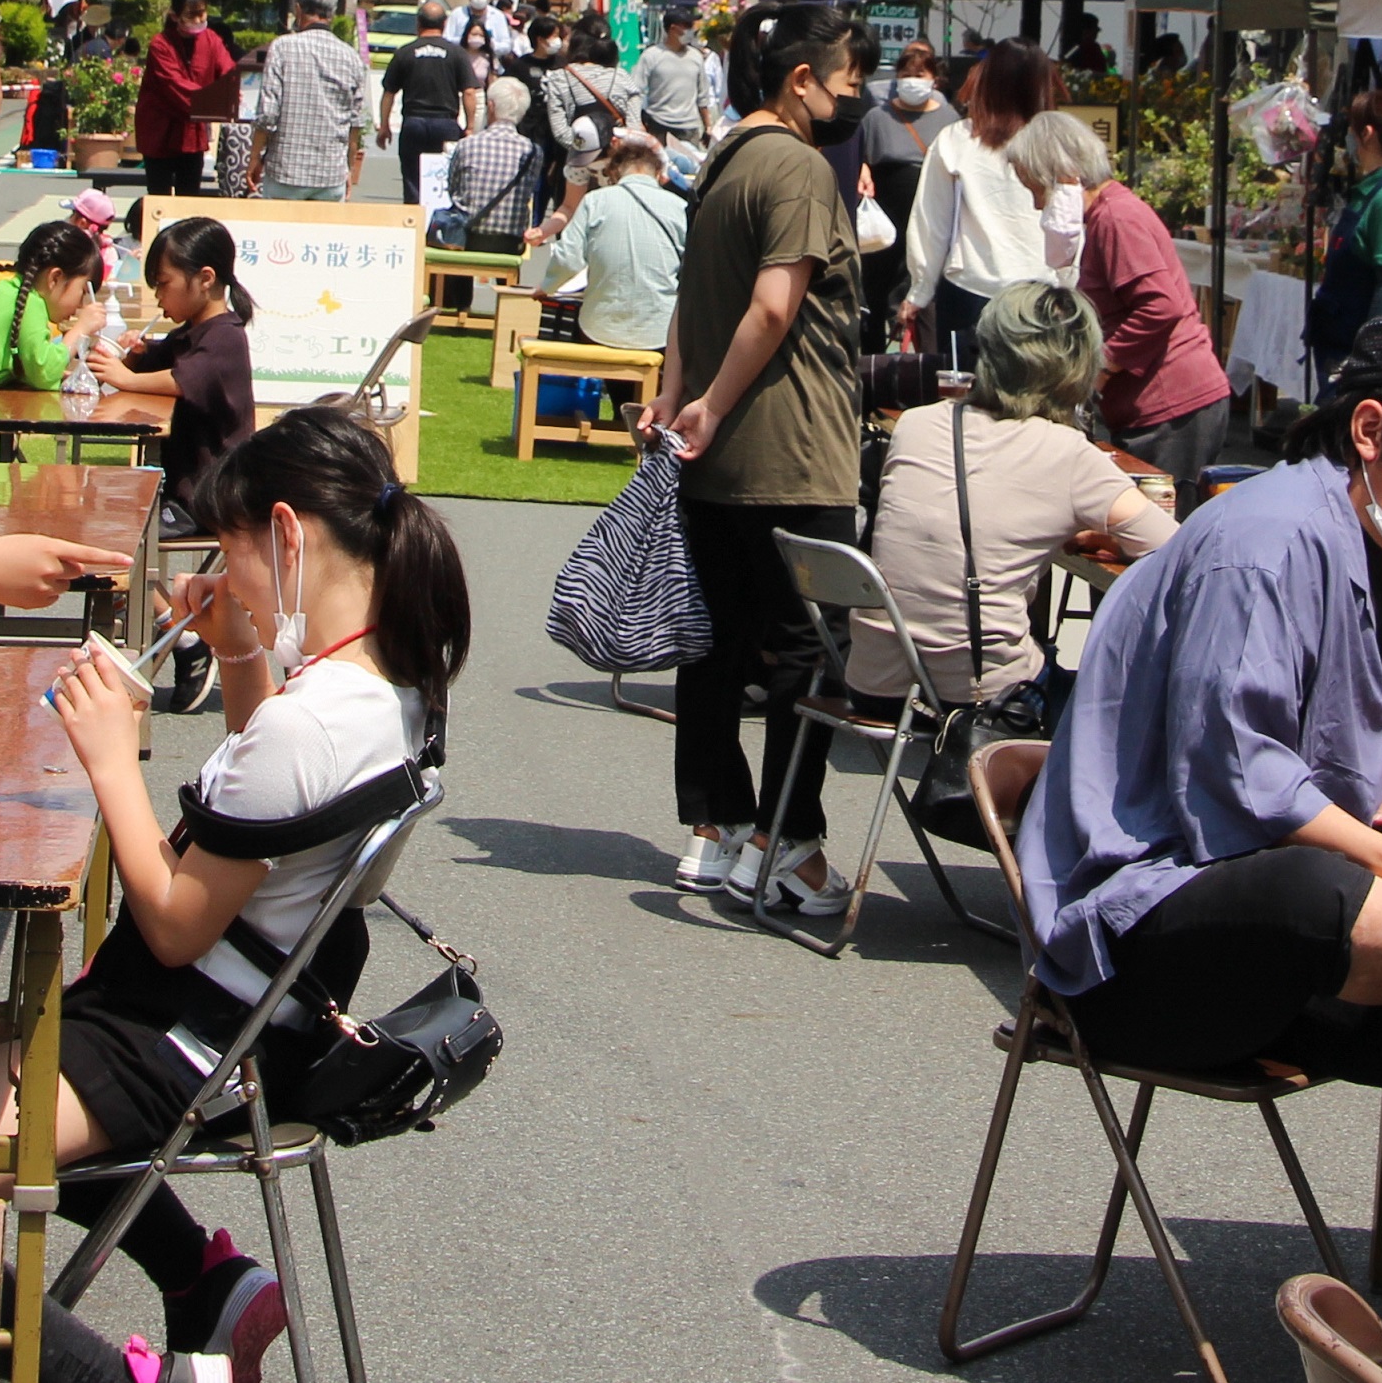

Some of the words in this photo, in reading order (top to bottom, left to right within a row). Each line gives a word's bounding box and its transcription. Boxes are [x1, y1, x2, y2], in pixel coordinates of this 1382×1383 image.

[300, 242, 405, 270] お散歩市
[250, 329, 391, 362] ろごろエリ
